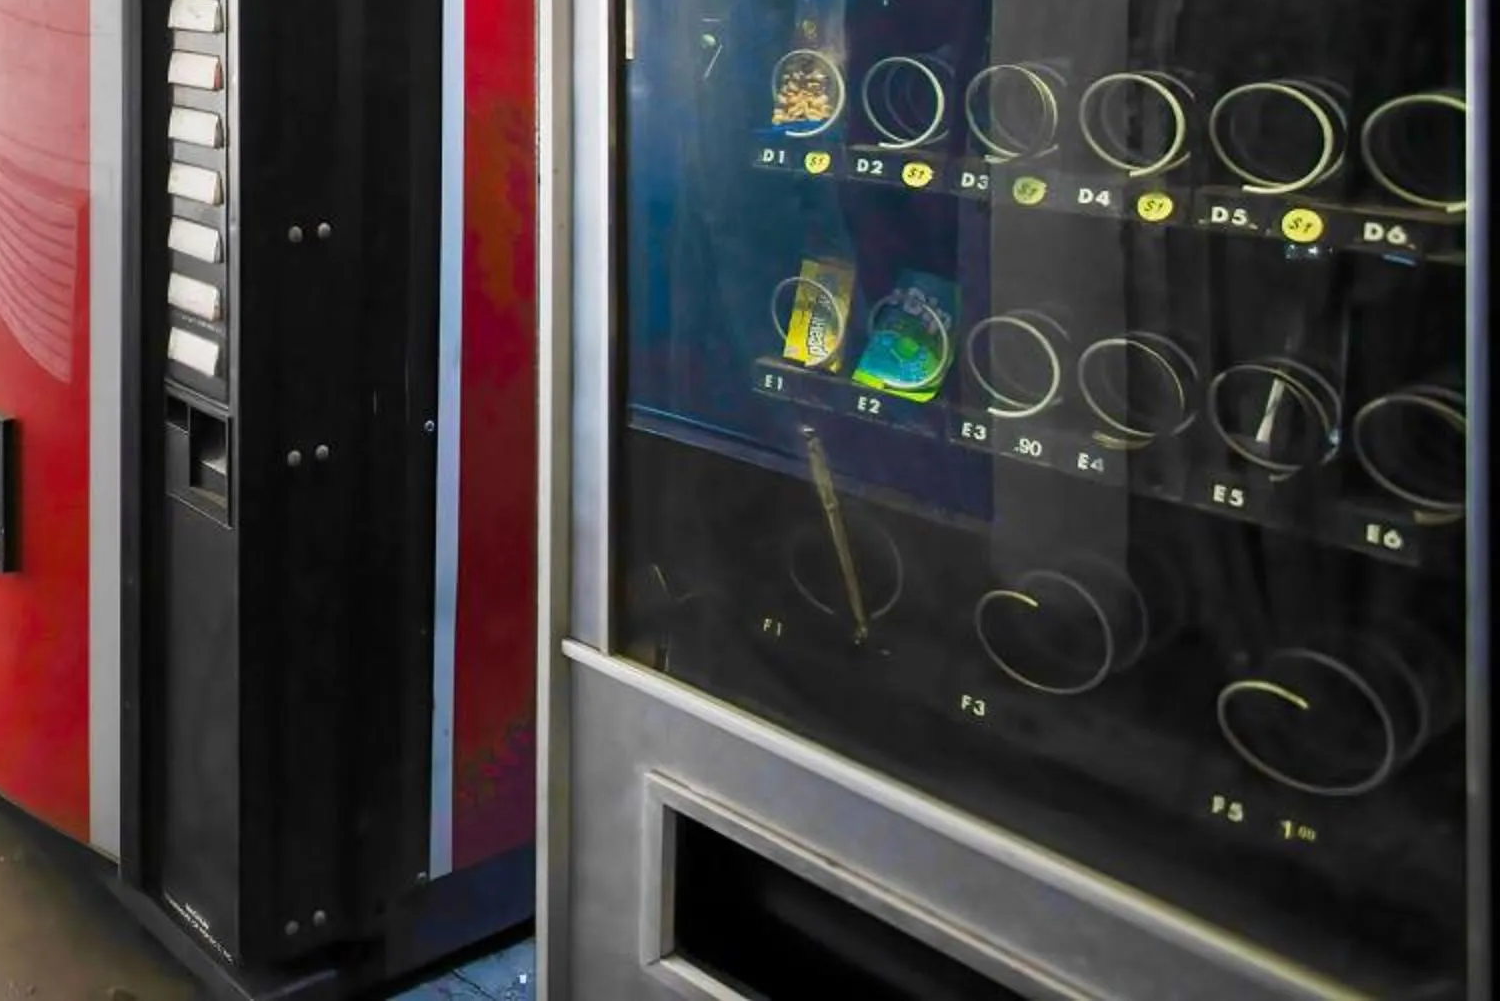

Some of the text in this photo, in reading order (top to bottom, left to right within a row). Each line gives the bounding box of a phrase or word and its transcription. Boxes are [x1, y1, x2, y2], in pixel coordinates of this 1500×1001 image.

[762, 148, 786, 164] D1
[856, 158, 884, 175] D2
[960, 172, 989, 190] D3
[1077, 188, 1111, 207] D4
[1210, 205, 1249, 227] D5
[1363, 221, 1407, 245] D6
[764, 374, 784, 391] E1
[856, 395, 882, 415] E2
[961, 421, 988, 440] E3
[1077, 452, 1105, 473] E4
[1213, 484, 1245, 508] E5
[1365, 523, 1404, 550] E6
[763, 617, 783, 637] F1
[961, 694, 986, 717] F3
[1211, 794, 1244, 822] F5
